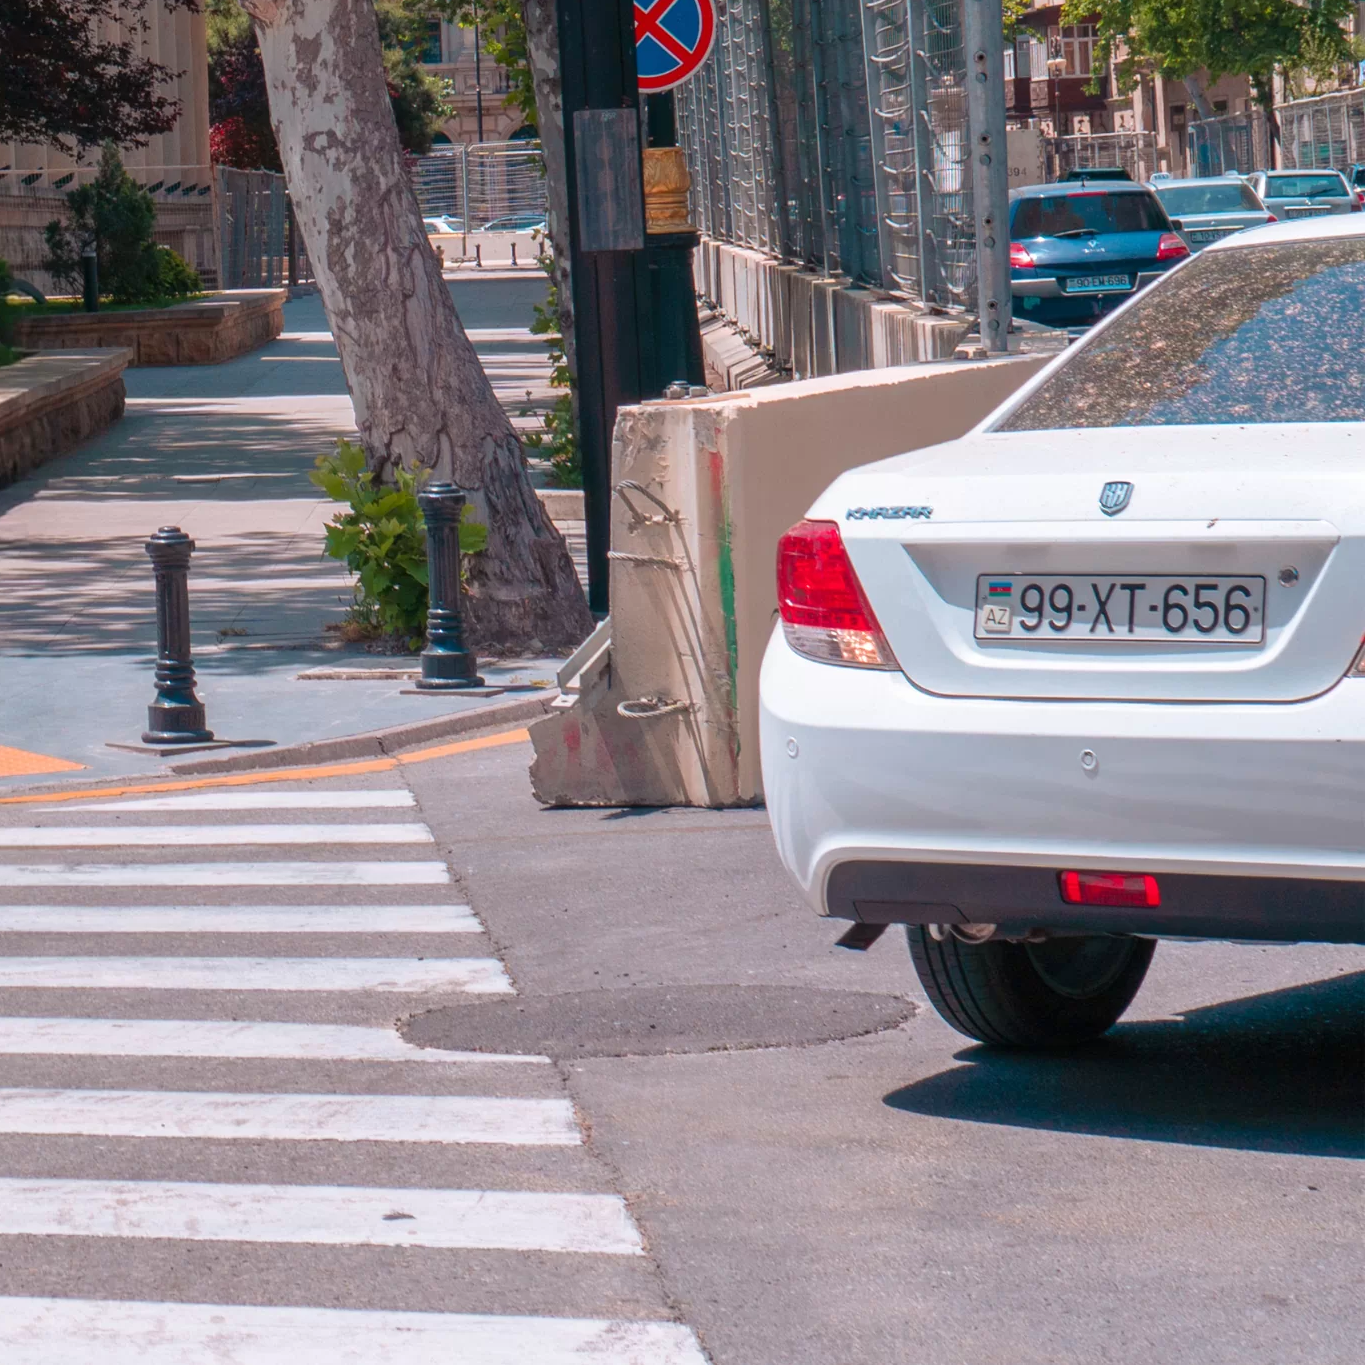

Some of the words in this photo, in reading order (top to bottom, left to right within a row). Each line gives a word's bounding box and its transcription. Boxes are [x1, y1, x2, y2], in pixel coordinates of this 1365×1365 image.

[845, 506, 935, 521] KHAZAR
[983, 608, 1007, 626] AZ
[1019, 582, 1253, 635] 99-XT-656
